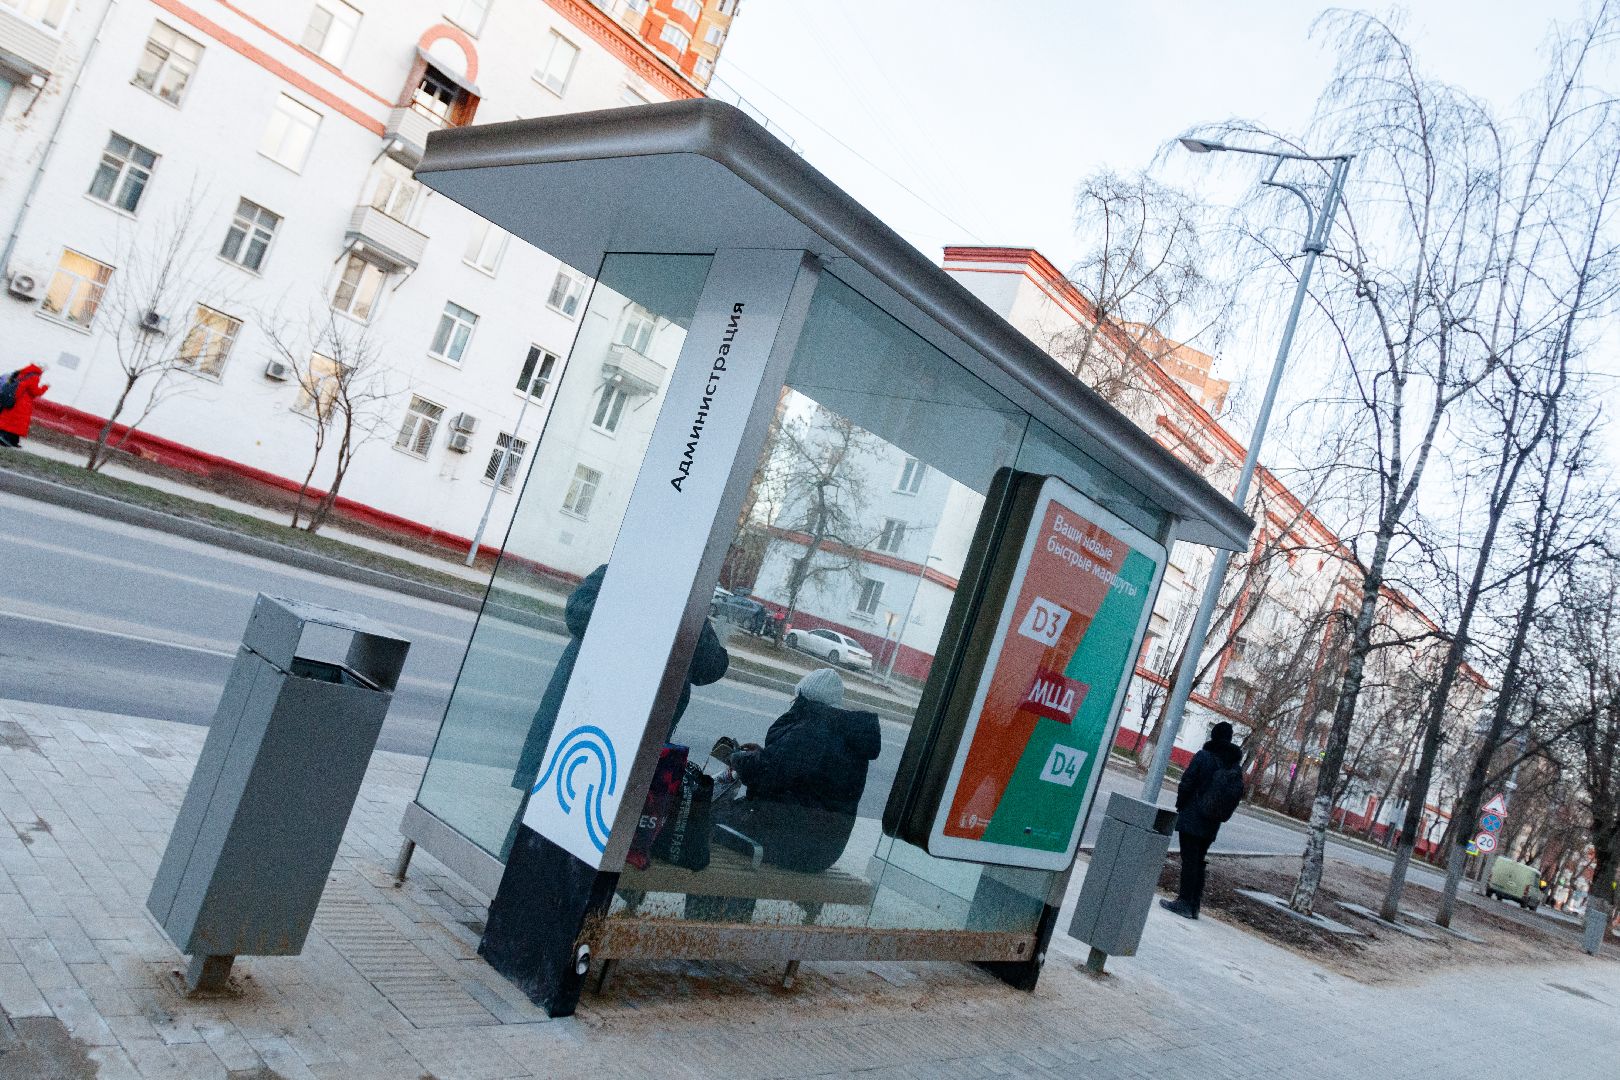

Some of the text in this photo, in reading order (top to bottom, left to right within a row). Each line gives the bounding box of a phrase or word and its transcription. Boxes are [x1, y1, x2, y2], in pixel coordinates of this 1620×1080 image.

[670, 302, 745, 493] Администрация
[1053, 514, 1113, 562] Ваши новые
[1047, 535, 1138, 596] быстрые маршруты
[1032, 605, 1061, 638] D3
[1028, 678, 1075, 714] МЦД
[1050, 751, 1077, 780] D4
[1479, 836, 1494, 848] 20
